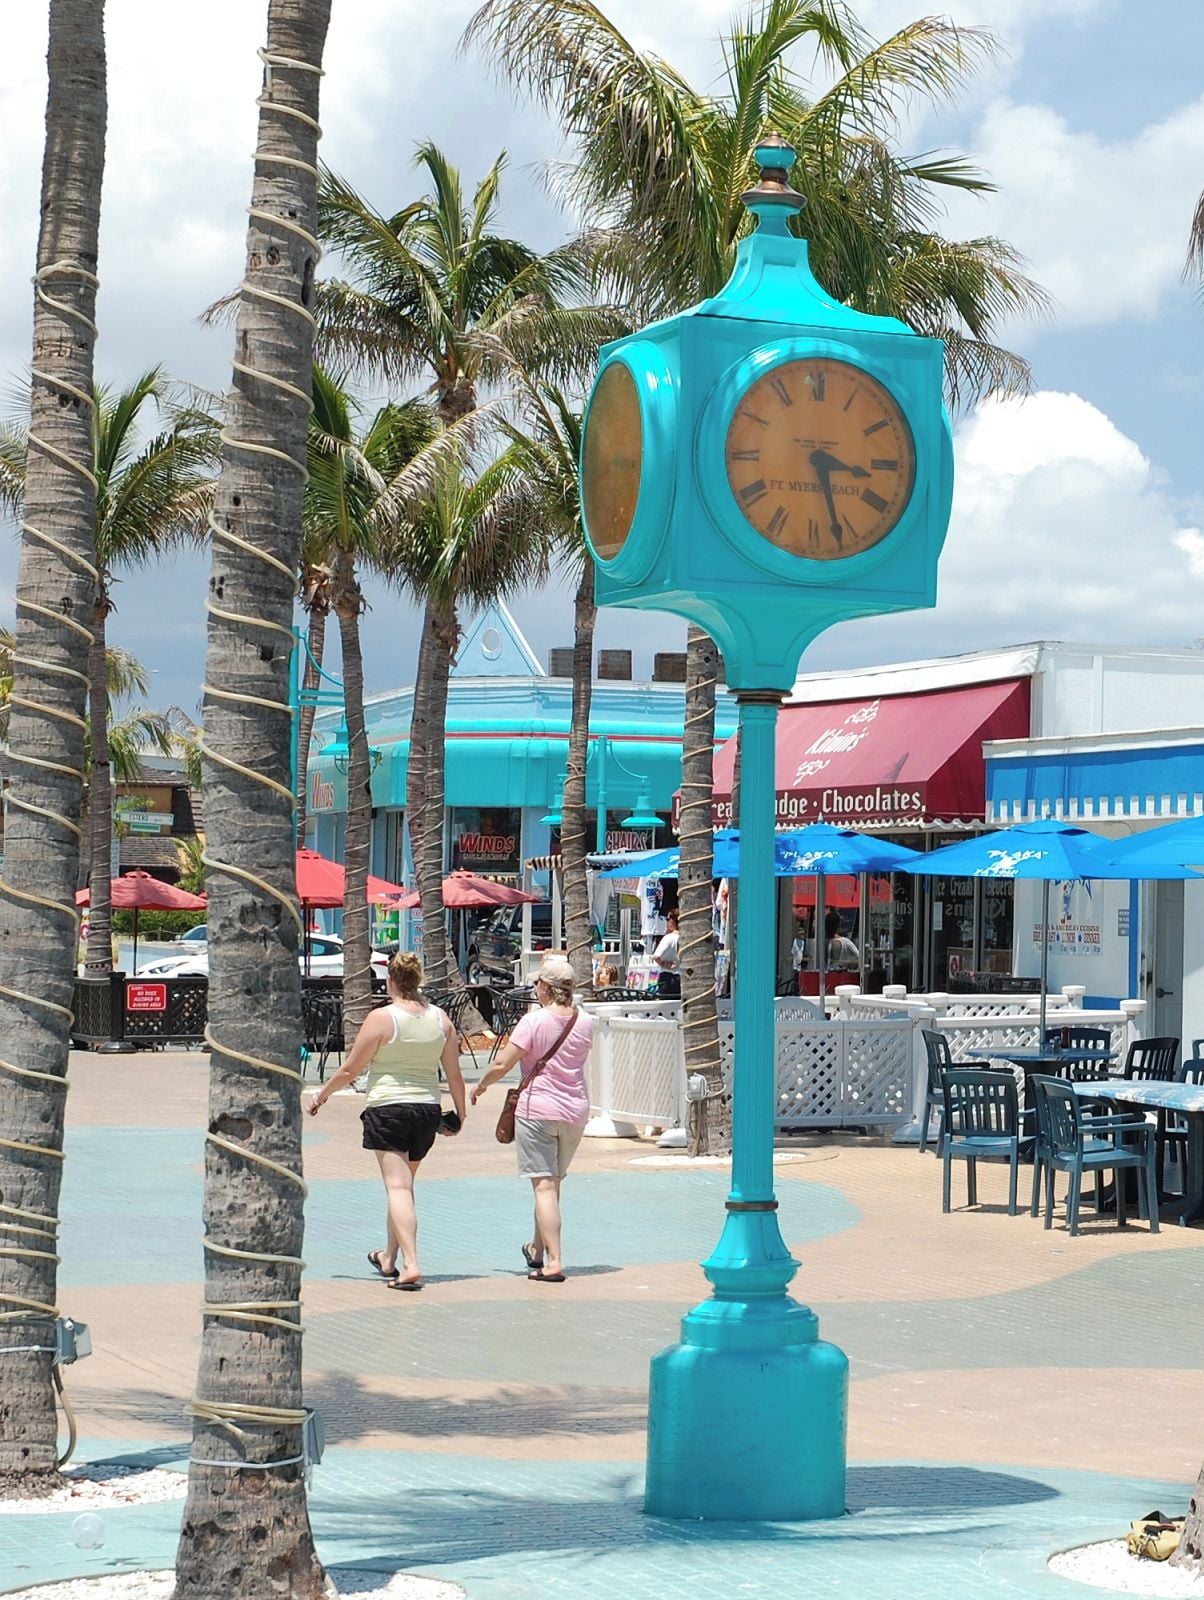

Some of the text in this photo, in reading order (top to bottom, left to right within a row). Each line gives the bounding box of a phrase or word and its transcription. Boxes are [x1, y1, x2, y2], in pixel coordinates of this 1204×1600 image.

[832, 483, 860, 496] EACH
[822, 786, 926, 813] Chocolates,
[459, 832, 516, 854] WINDS
